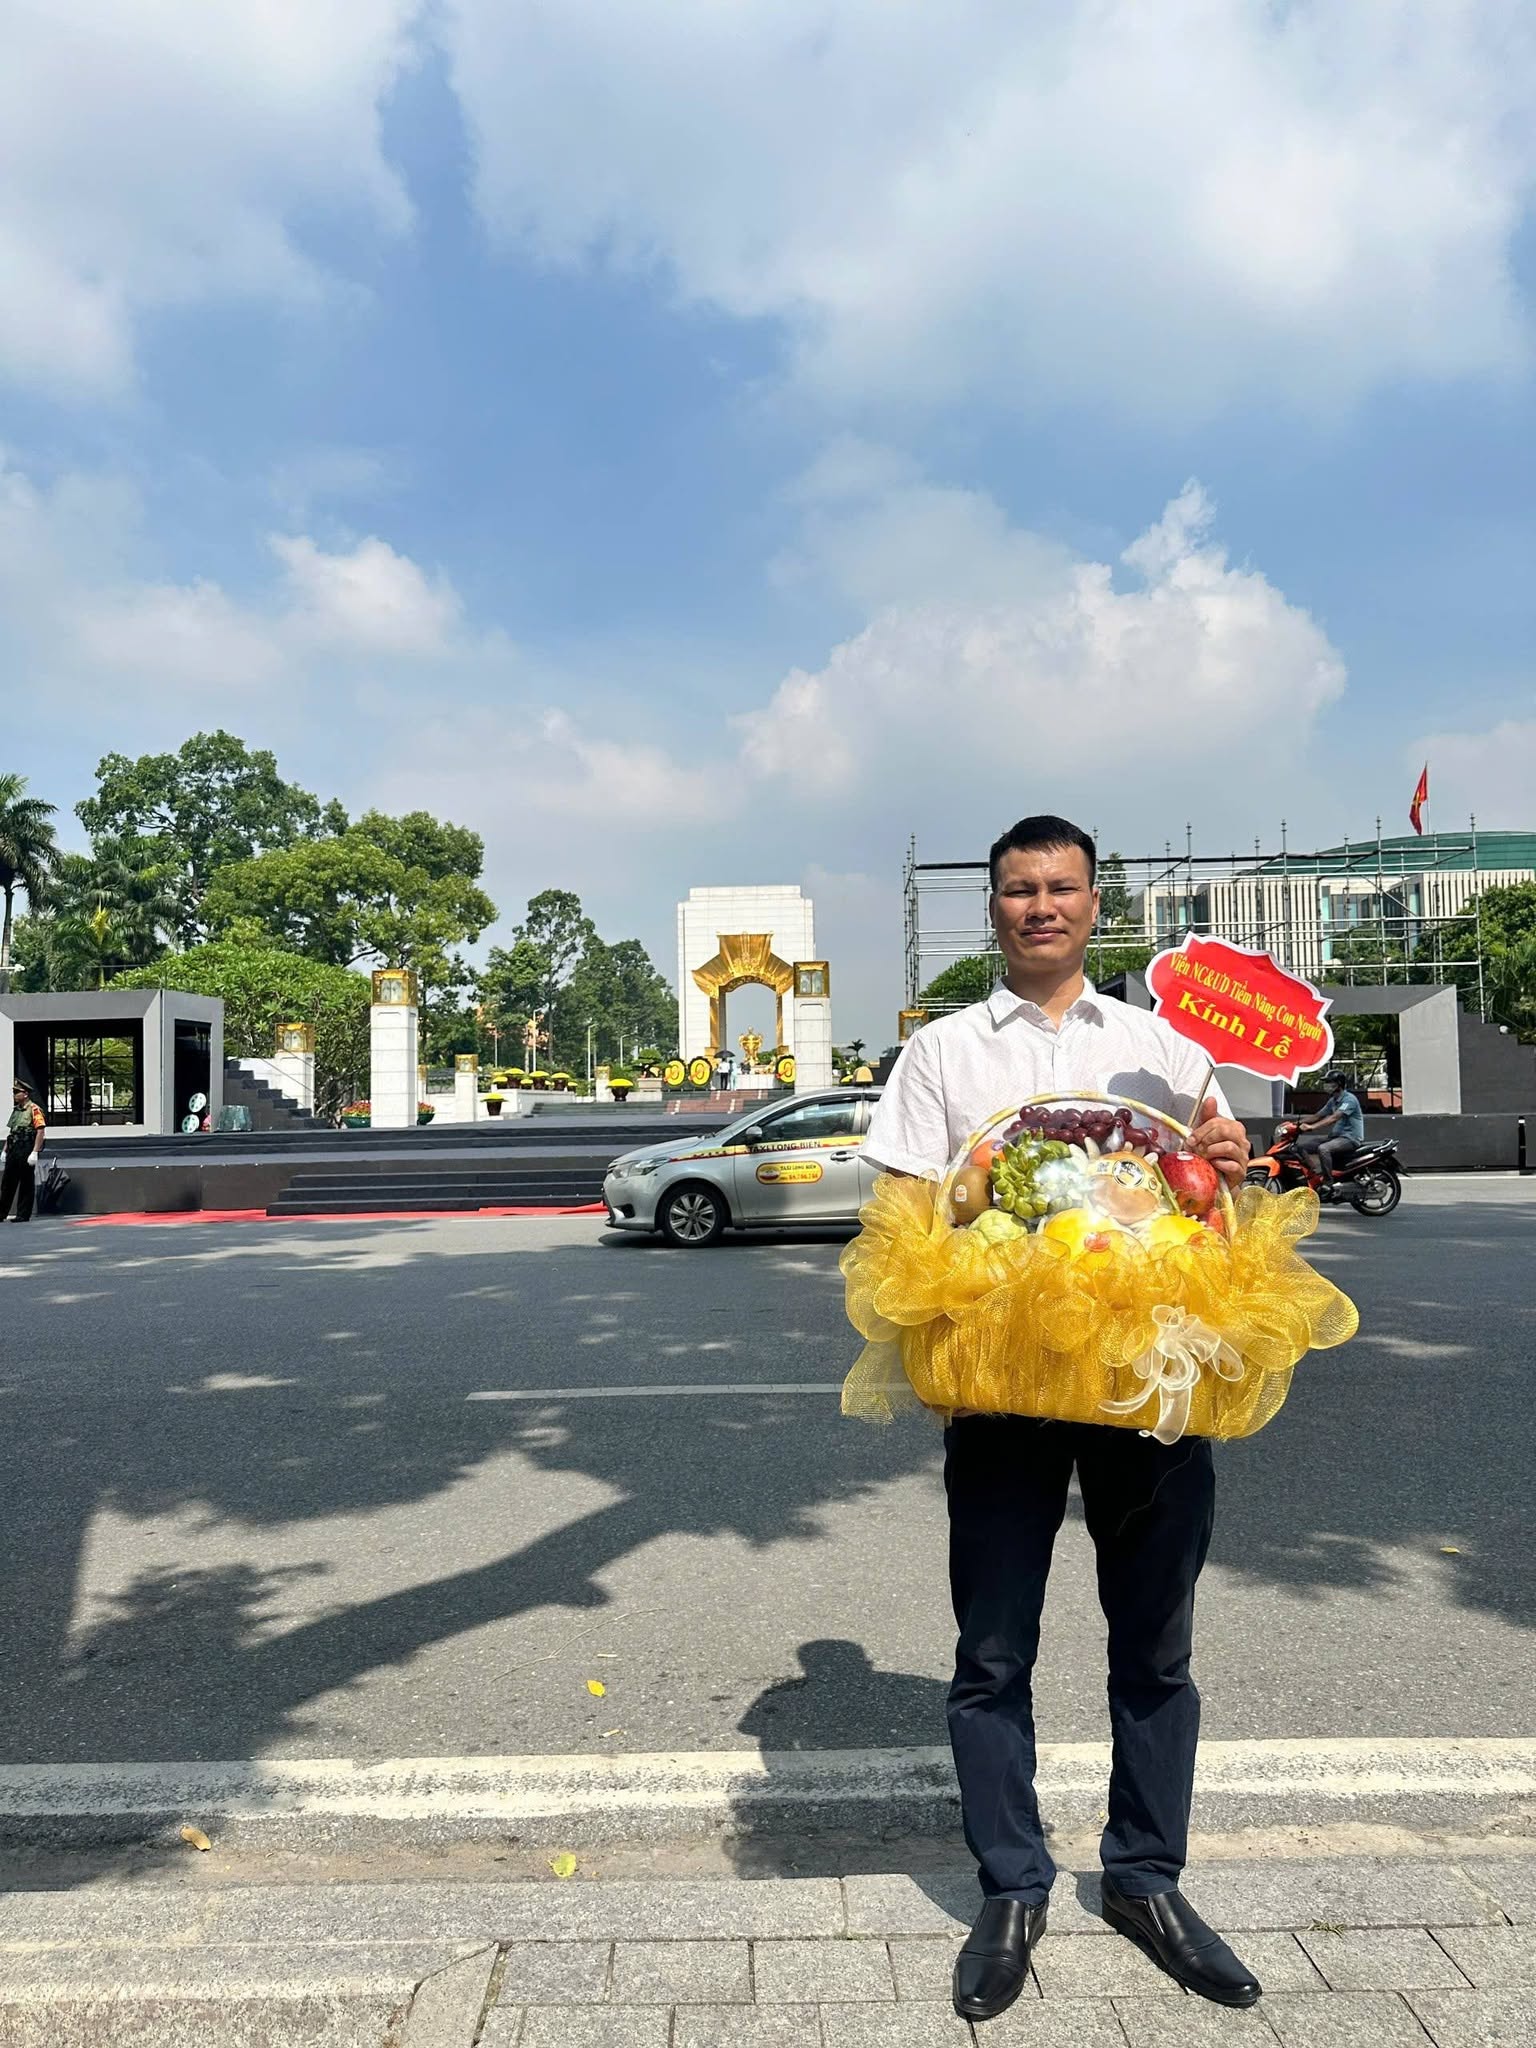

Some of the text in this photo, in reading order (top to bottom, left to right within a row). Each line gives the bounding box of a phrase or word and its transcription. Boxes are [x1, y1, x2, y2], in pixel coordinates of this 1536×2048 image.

[1170, 953, 1191, 976] Viện
[1276, 1005, 1295, 1027] Con
[1294, 1014, 1323, 1040] Người
[1178, 990, 1293, 1058] Kính Lễ
[748, 1144, 770, 1153] TAXI
[771, 1142, 797, 1151] LONG
